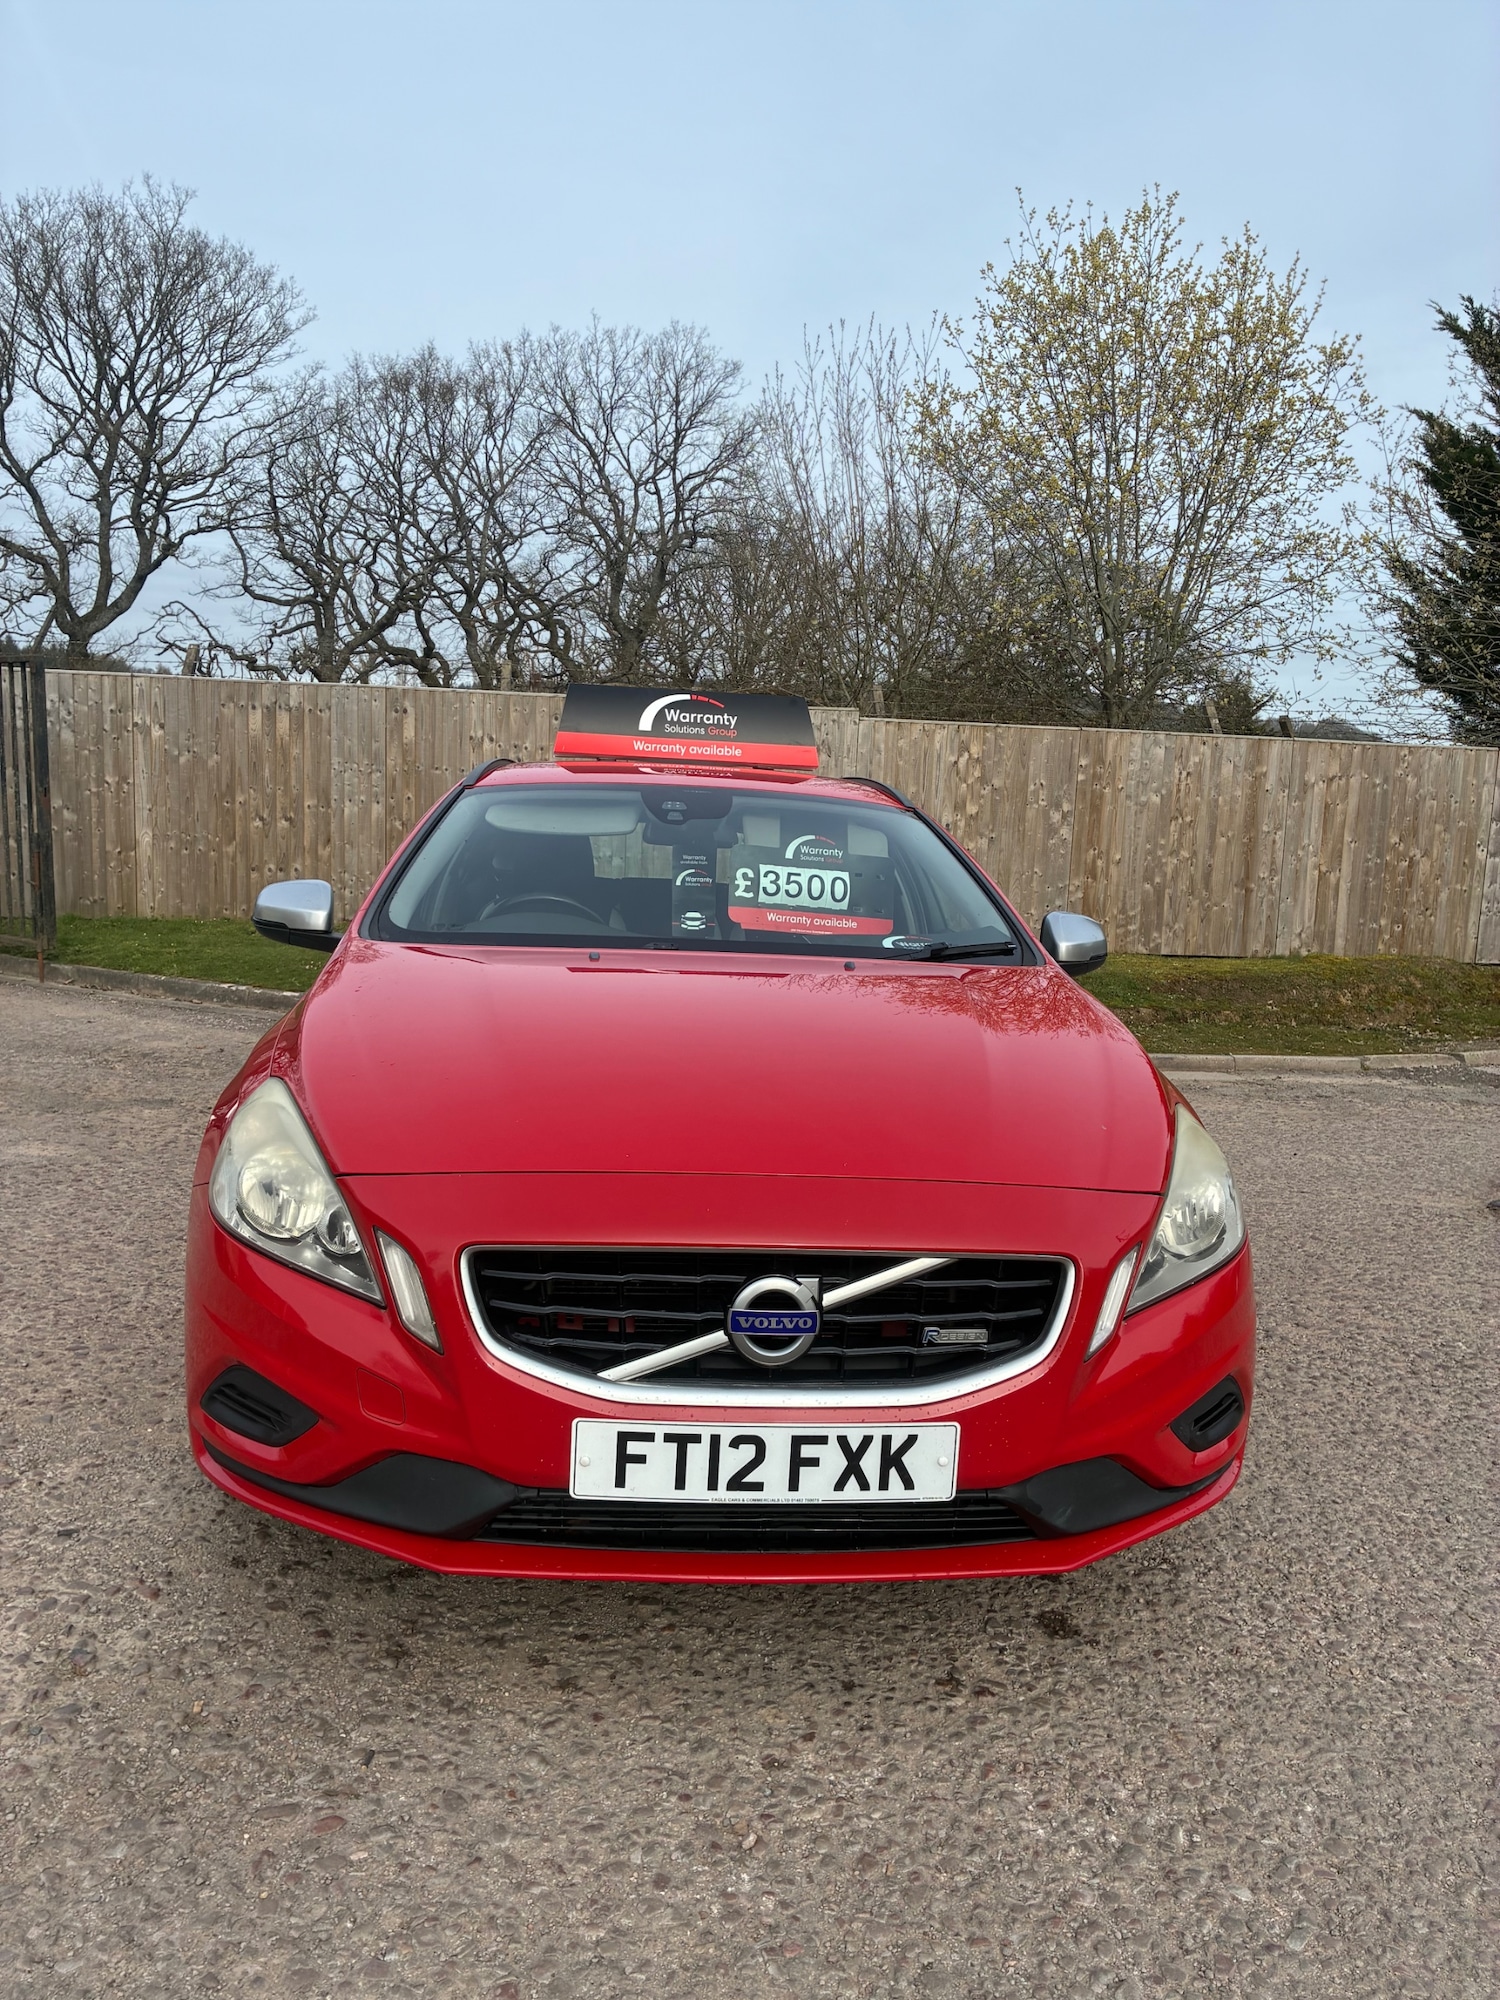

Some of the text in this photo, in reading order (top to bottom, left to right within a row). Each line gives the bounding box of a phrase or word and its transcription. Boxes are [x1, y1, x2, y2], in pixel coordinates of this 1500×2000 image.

[665, 708, 738, 729] Warranty
[664, 723, 738, 738] Solutions Group
[633, 739, 742, 757] Warranty available
[800, 844, 843, 860] Warranty
[800, 854, 825, 863] Solutions
[685, 876, 713, 885] Warranty
[766, 911, 858, 929] Warranty available
[735, 1316, 812, 1329] VOLVO
[614, 1430, 918, 1492] FT12 FXK
